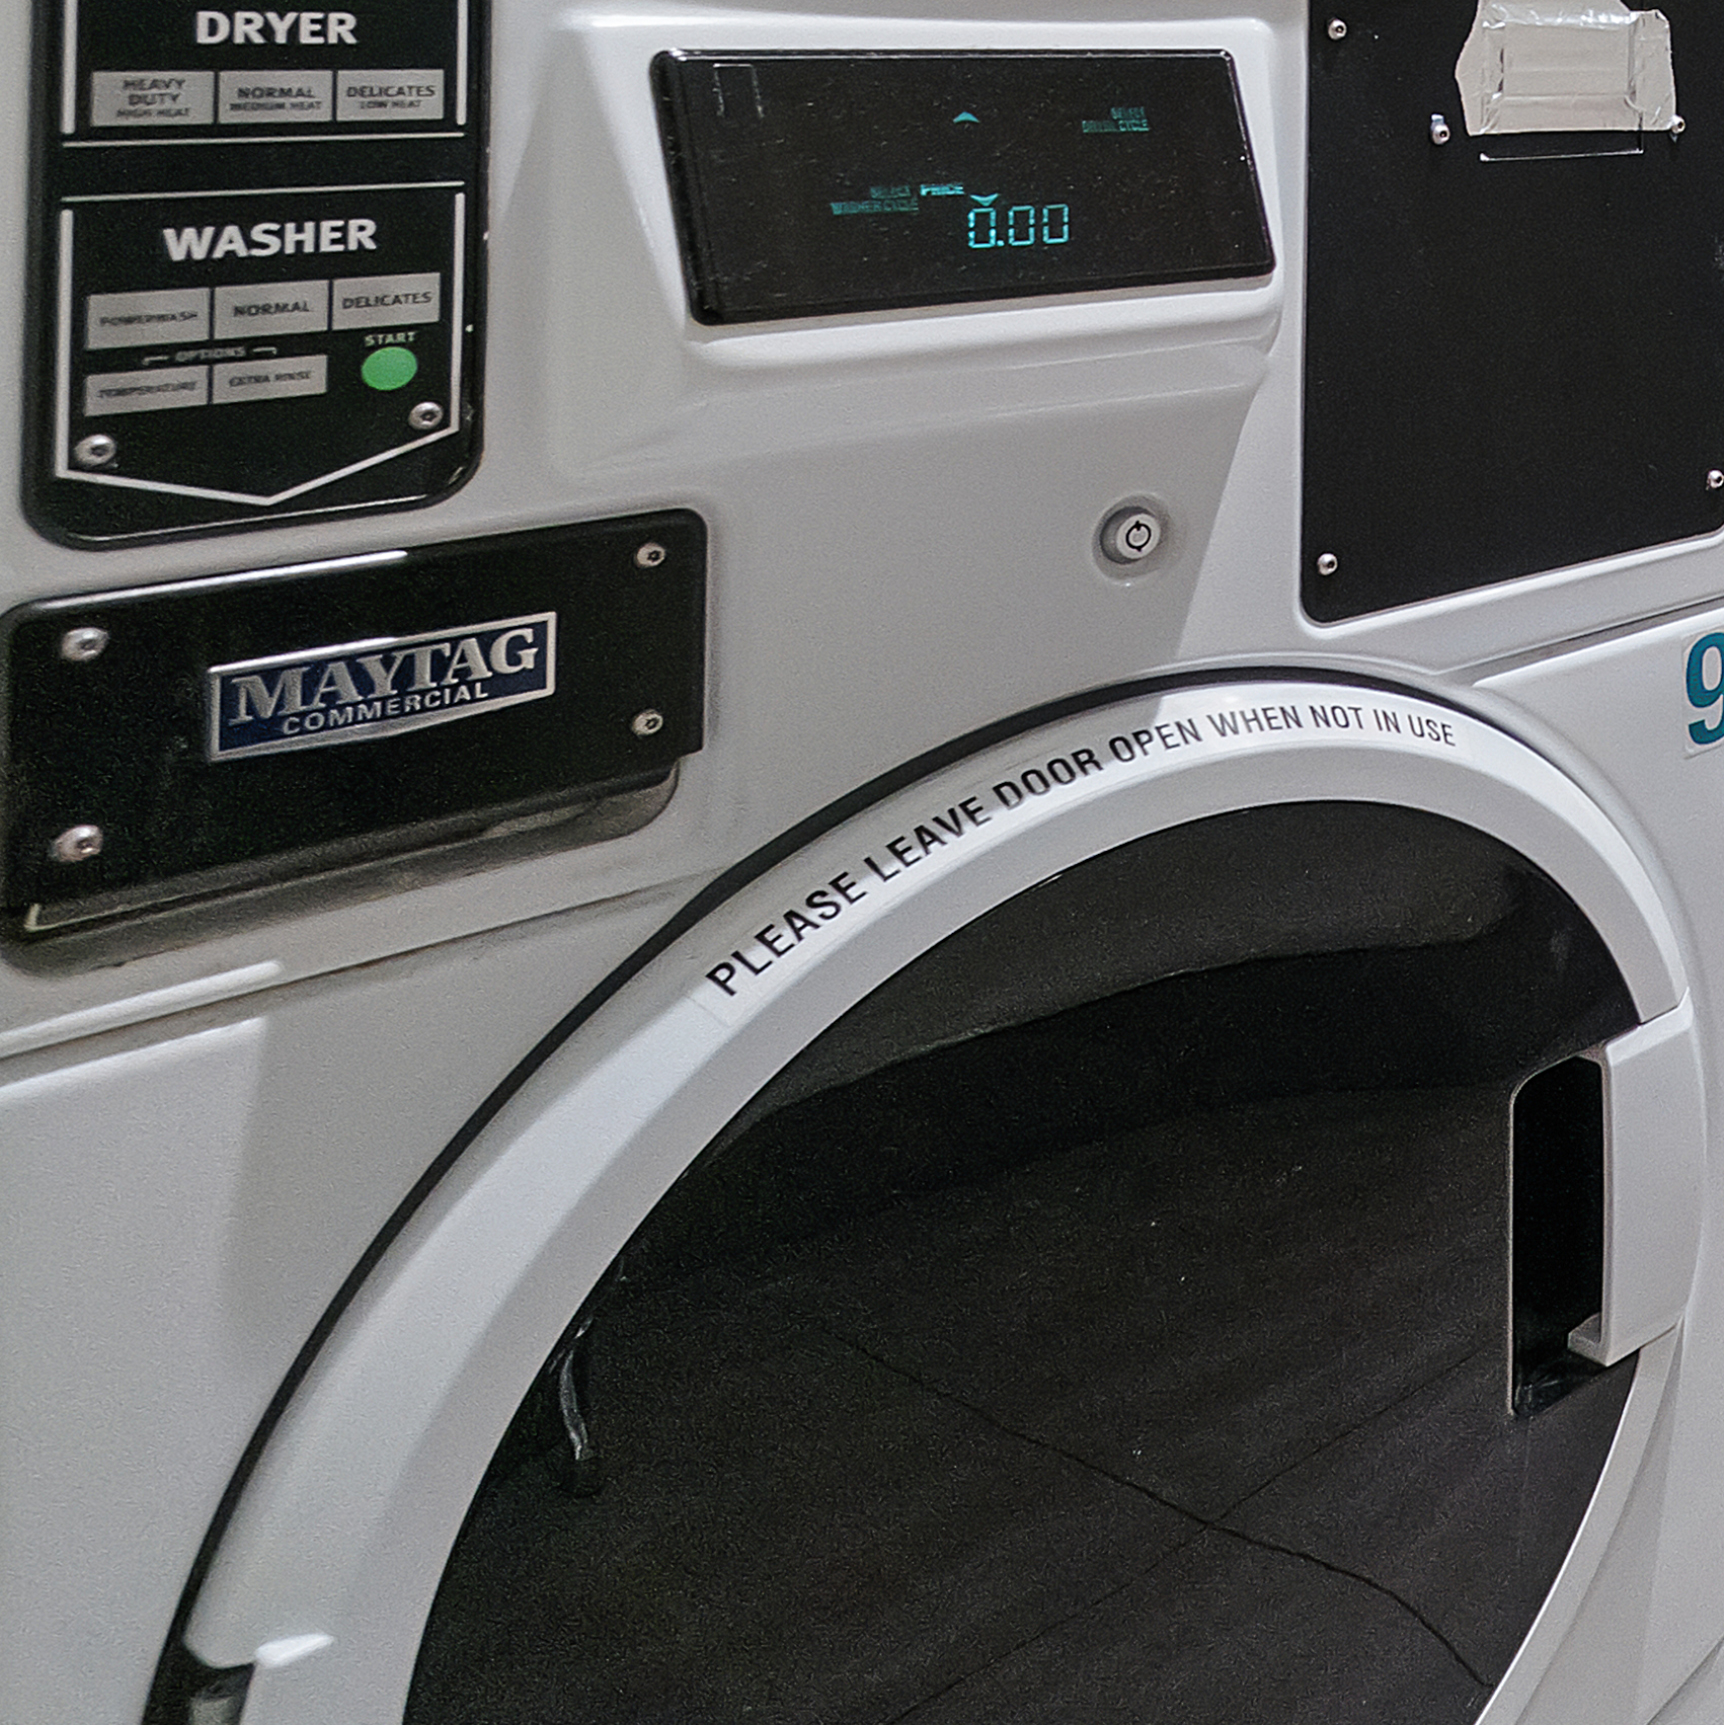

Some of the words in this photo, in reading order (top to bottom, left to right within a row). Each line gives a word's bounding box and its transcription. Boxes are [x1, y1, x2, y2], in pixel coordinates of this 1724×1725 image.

[195, 9, 358, 46] DRYER
[122, 78, 187, 91] HEAVY
[236, 86, 316, 99] NORMAL
[345, 84, 436, 98] DELICATES
[128, 92, 179, 106] DUTY
[967, 203, 1070, 249] 0.00
[163, 219, 379, 263] WASHER
[232, 300, 311, 318] NORMAL
[341, 291, 433, 310] DELICATES
[363, 331, 418, 348] START
[227, 626, 540, 728] MAYTAG
[281, 680, 490, 738] COMMERCIAL
[705, 870, 869, 998] PLEASE
[864, 791, 993, 883] LEAVE
[991, 745, 1103, 813] DOOR
[1108, 716, 1205, 764] OPEN
[1205, 704, 1304, 741] WHEN
[1310, 704, 1366, 731] NOT
[1373, 708, 1402, 734] IN
[1407, 712, 1457, 747] USE
